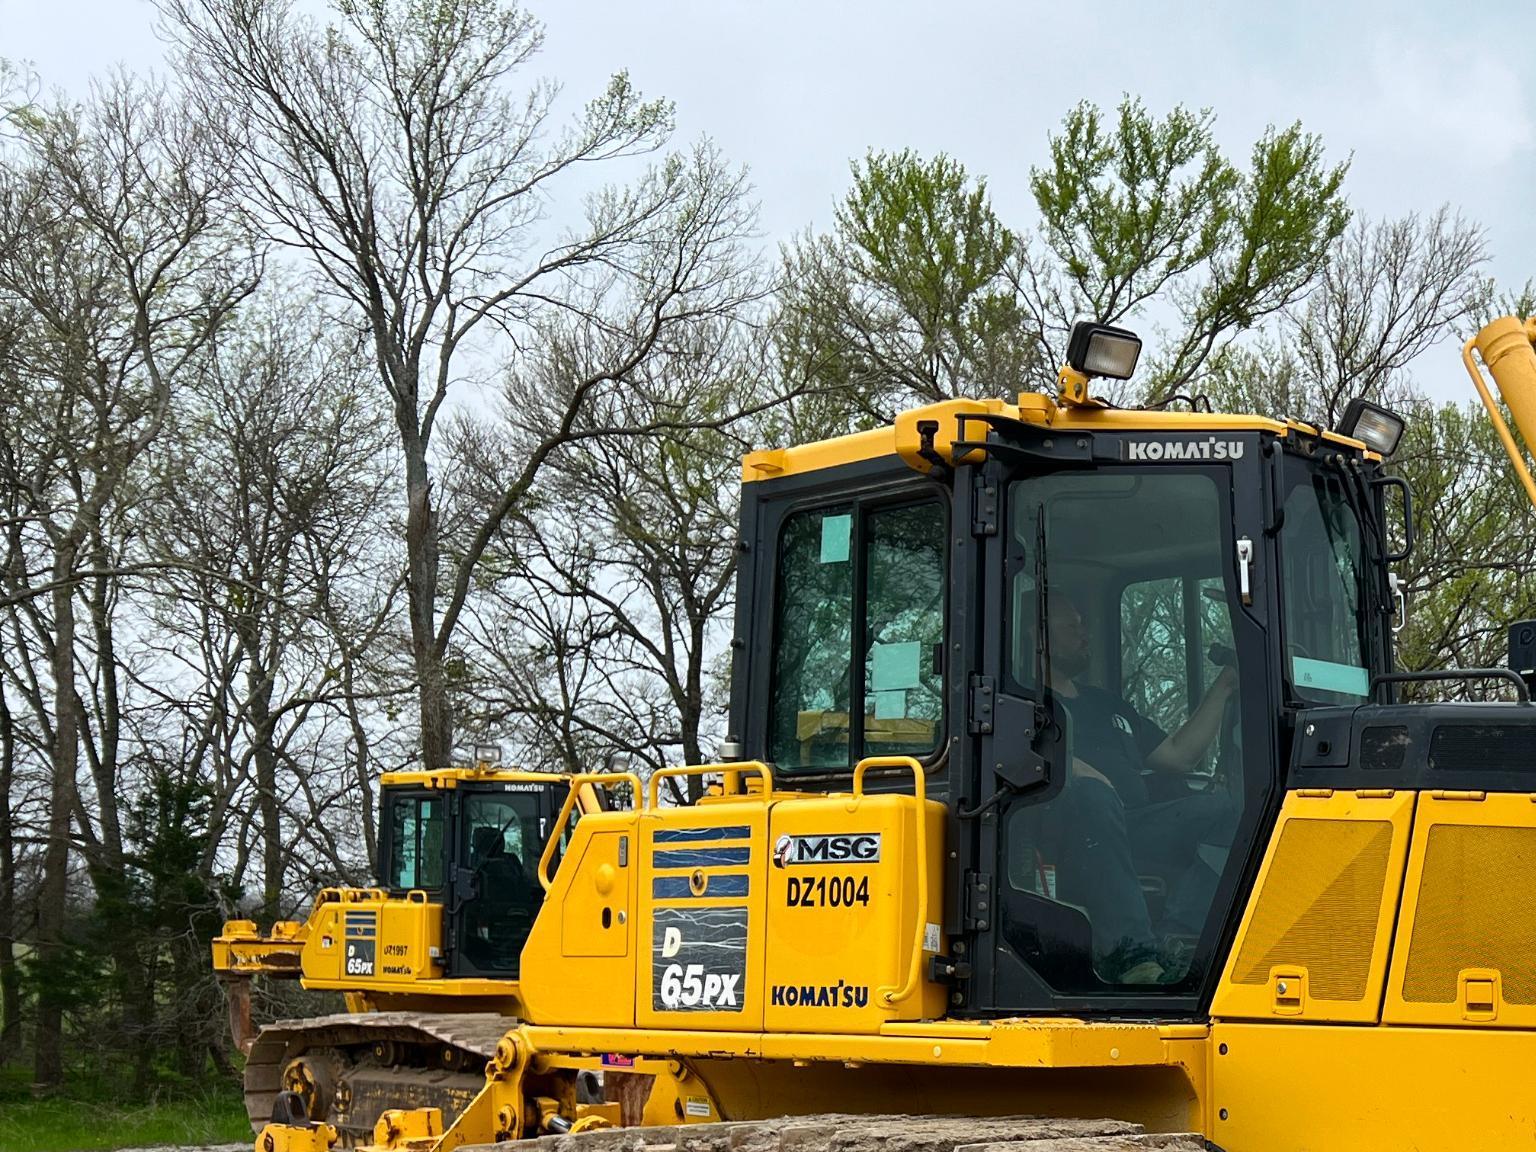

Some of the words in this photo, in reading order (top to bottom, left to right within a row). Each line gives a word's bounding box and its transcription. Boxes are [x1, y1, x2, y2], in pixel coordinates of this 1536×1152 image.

[1128, 436, 1244, 460] KOMATSU
[504, 783, 545, 792] KOMATSU
[798, 836, 878, 861] MSG
[787, 876, 869, 907] DZ1004
[347, 945, 355, 957] D
[662, 927, 681, 957] D
[347, 958, 373, 974] 65PX
[661, 964, 740, 1009] 65PX
[772, 979, 868, 1008] KOMATSU
